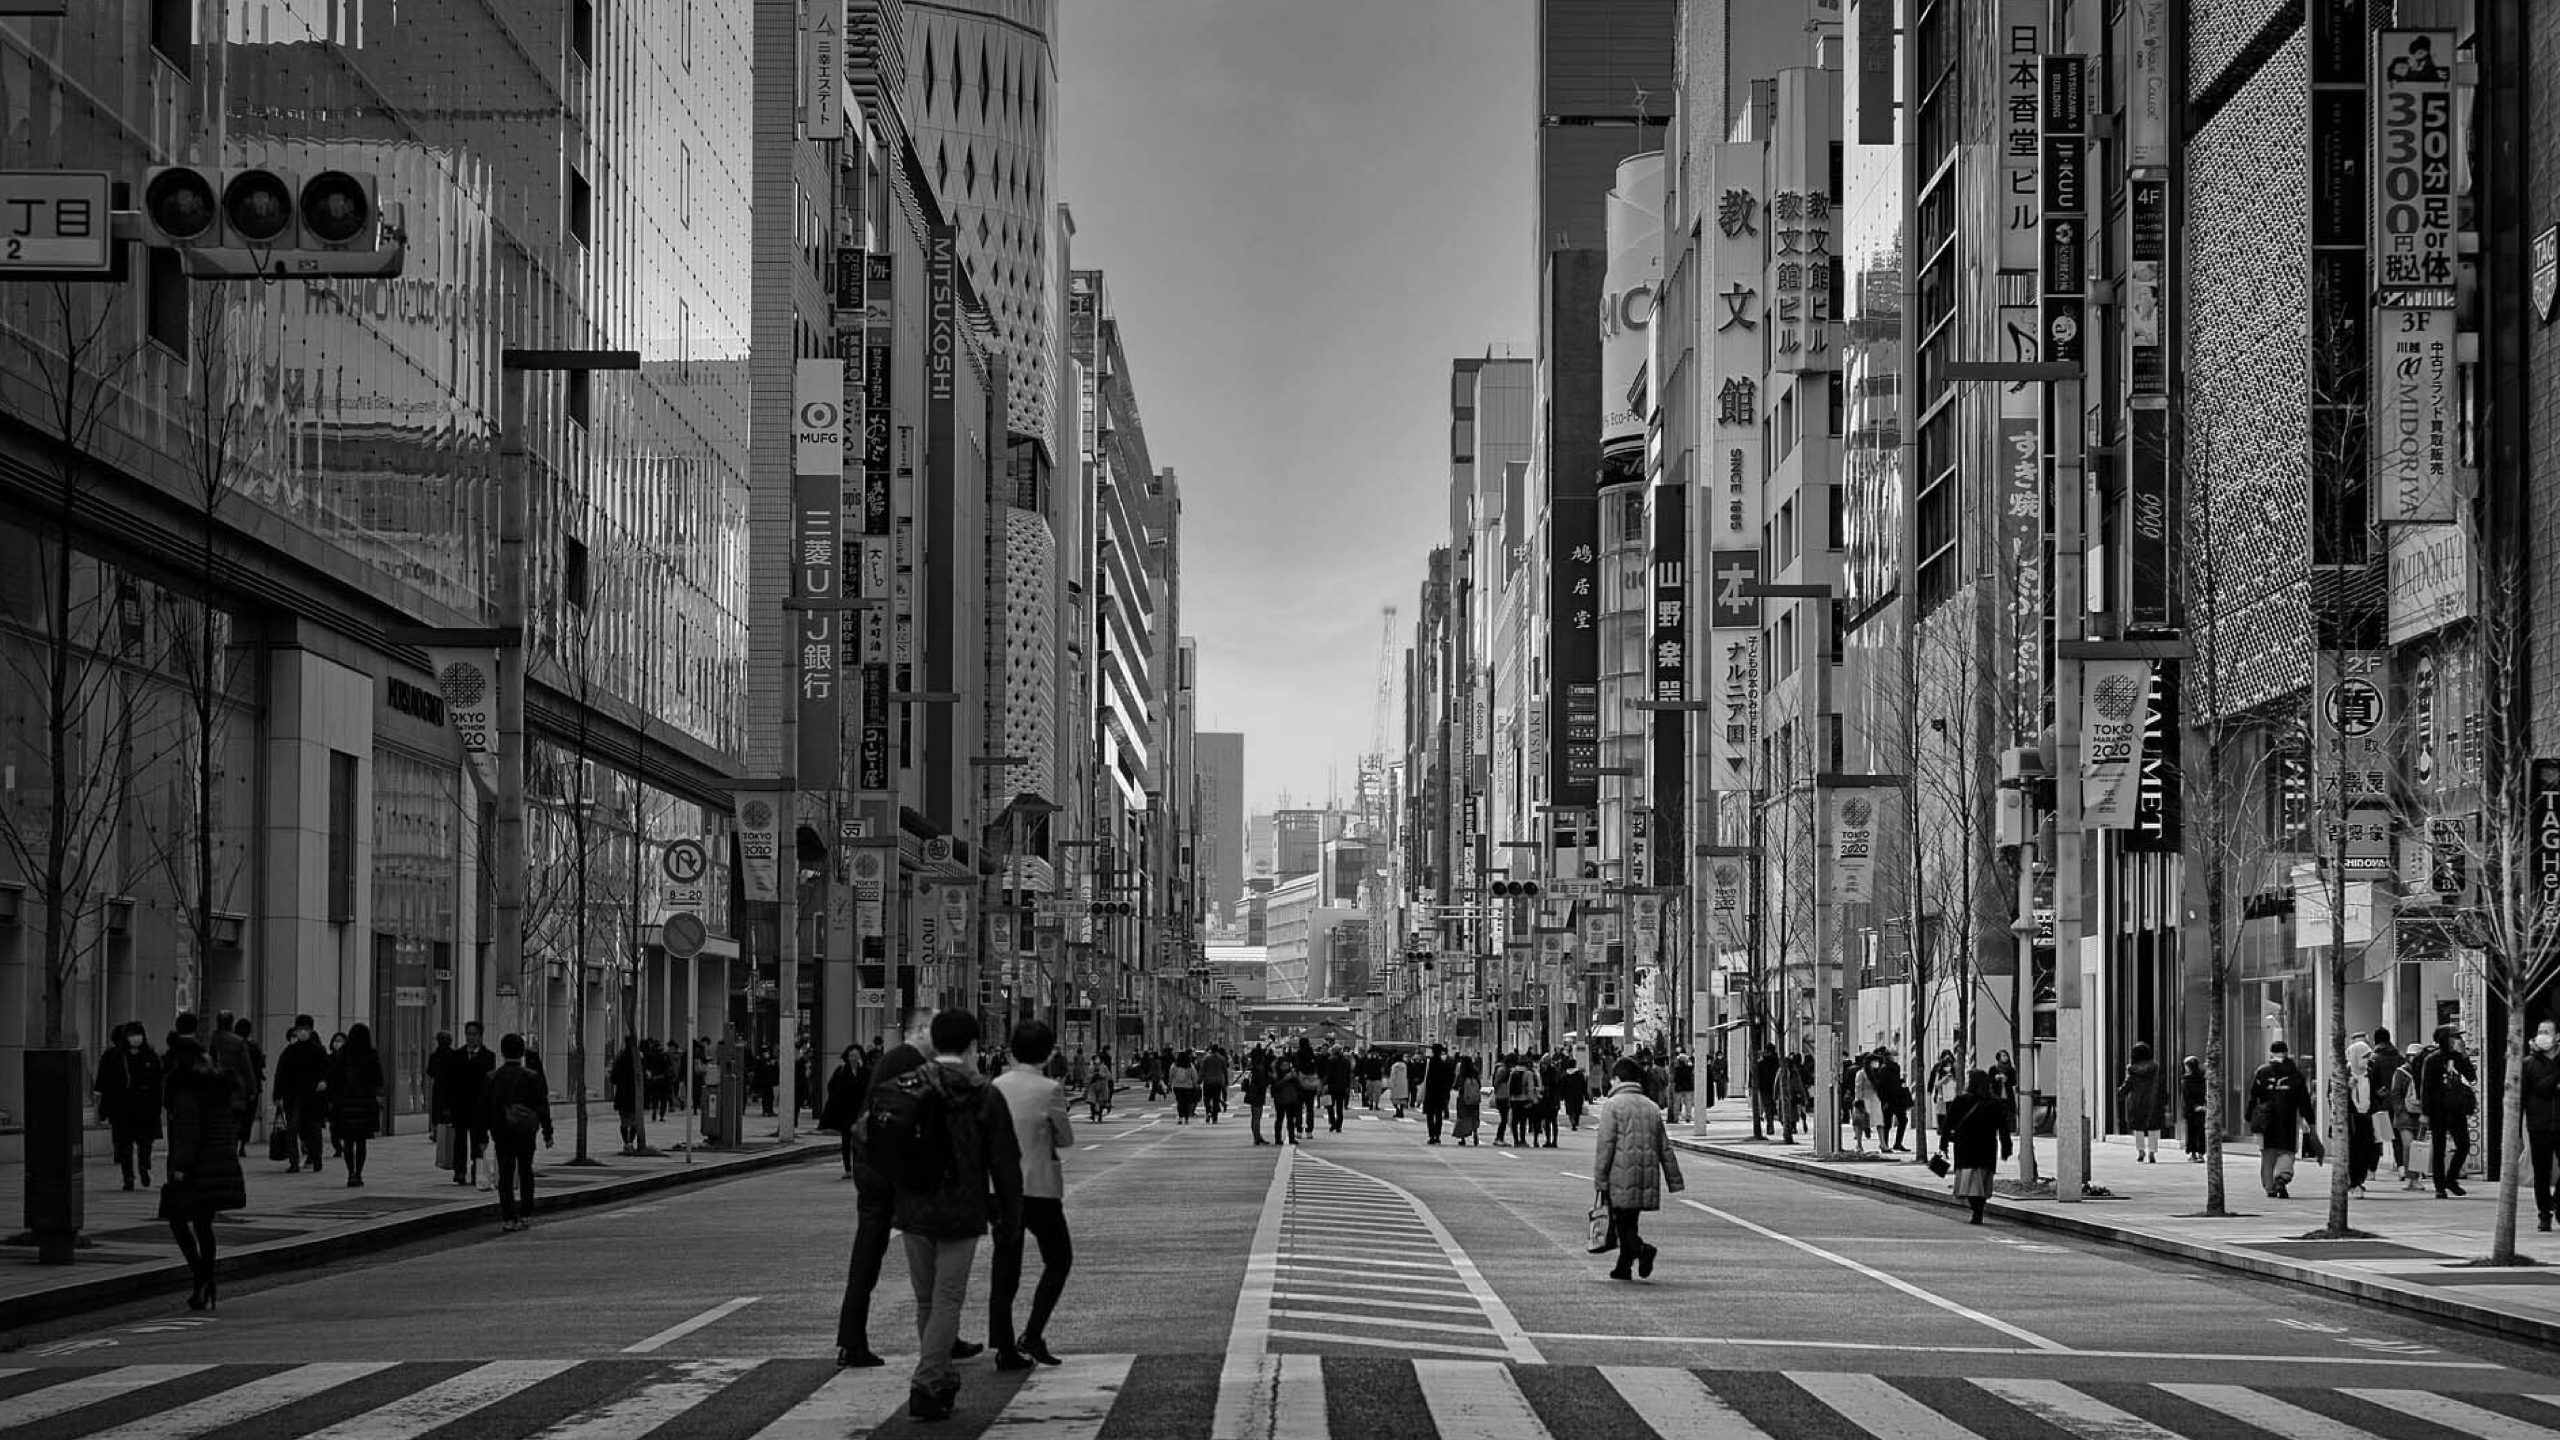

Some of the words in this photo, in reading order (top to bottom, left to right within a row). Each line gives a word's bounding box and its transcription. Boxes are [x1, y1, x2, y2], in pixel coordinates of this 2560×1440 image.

[817, 40, 831, 125] 三幸エステート
[2009, 26, 2039, 231] 日本香堂ビル
[2424, 99, 2448, 189] 50分
[2137, 188, 2160, 205] 4F
[2386, 92, 2420, 252] 3300円
[6, 198, 90, 237] 丁目
[6, 238, 22, 260] 2
[1777, 189, 1804, 355] 教文館ビル
[1806, 189, 1830, 355] 教文館ビル
[2386, 254, 2420, 281] 税込
[931, 237, 952, 400] MITSUKOSHI
[1719, 188, 1758, 426] 教文館
[2400, 311, 2432, 333] 3F
[2430, 340, 2445, 475] 中古ブランド買取販売
[800, 433, 838, 443] MUFG
[2399, 383, 2421, 516] MIDORIYA
[1730, 448, 1743, 493] SINCE
[1571, 543, 1594, 630] 鳩居堂
[1717, 562, 1756, 616] 本
[2346, 656, 2383, 674] 2F
[1726, 641, 1746, 744] ナルニア国
[2332, 686, 2377, 729] 質
[1477, 702, 1486, 741] docomo
[1529, 710, 1541, 766] TASAKI
[2092, 744, 2132, 758] 2020
[743, 832, 772, 841] TOKYO
[2541, 790, 2560, 849] TAG
[744, 846, 773, 855] 2020
[1841, 844, 1869, 854] 2020
